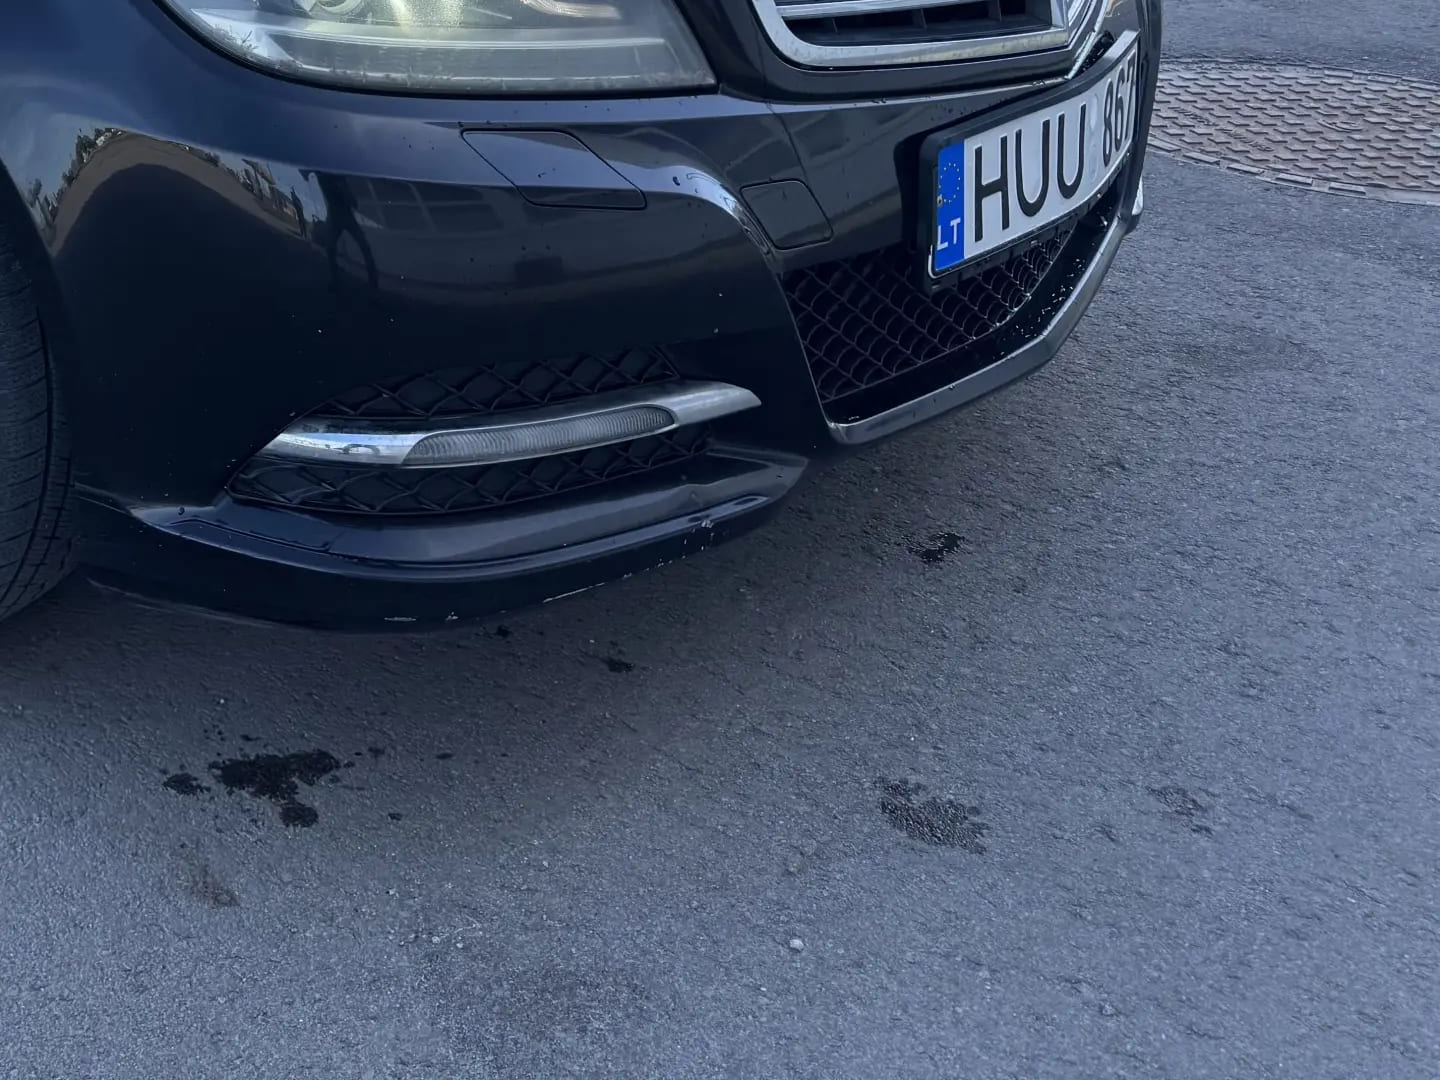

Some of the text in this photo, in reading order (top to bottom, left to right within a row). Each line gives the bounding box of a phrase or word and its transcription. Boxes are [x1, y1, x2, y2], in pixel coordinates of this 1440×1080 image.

[974, 51, 1137, 243] HUU 867
[936, 218, 962, 250] LT
